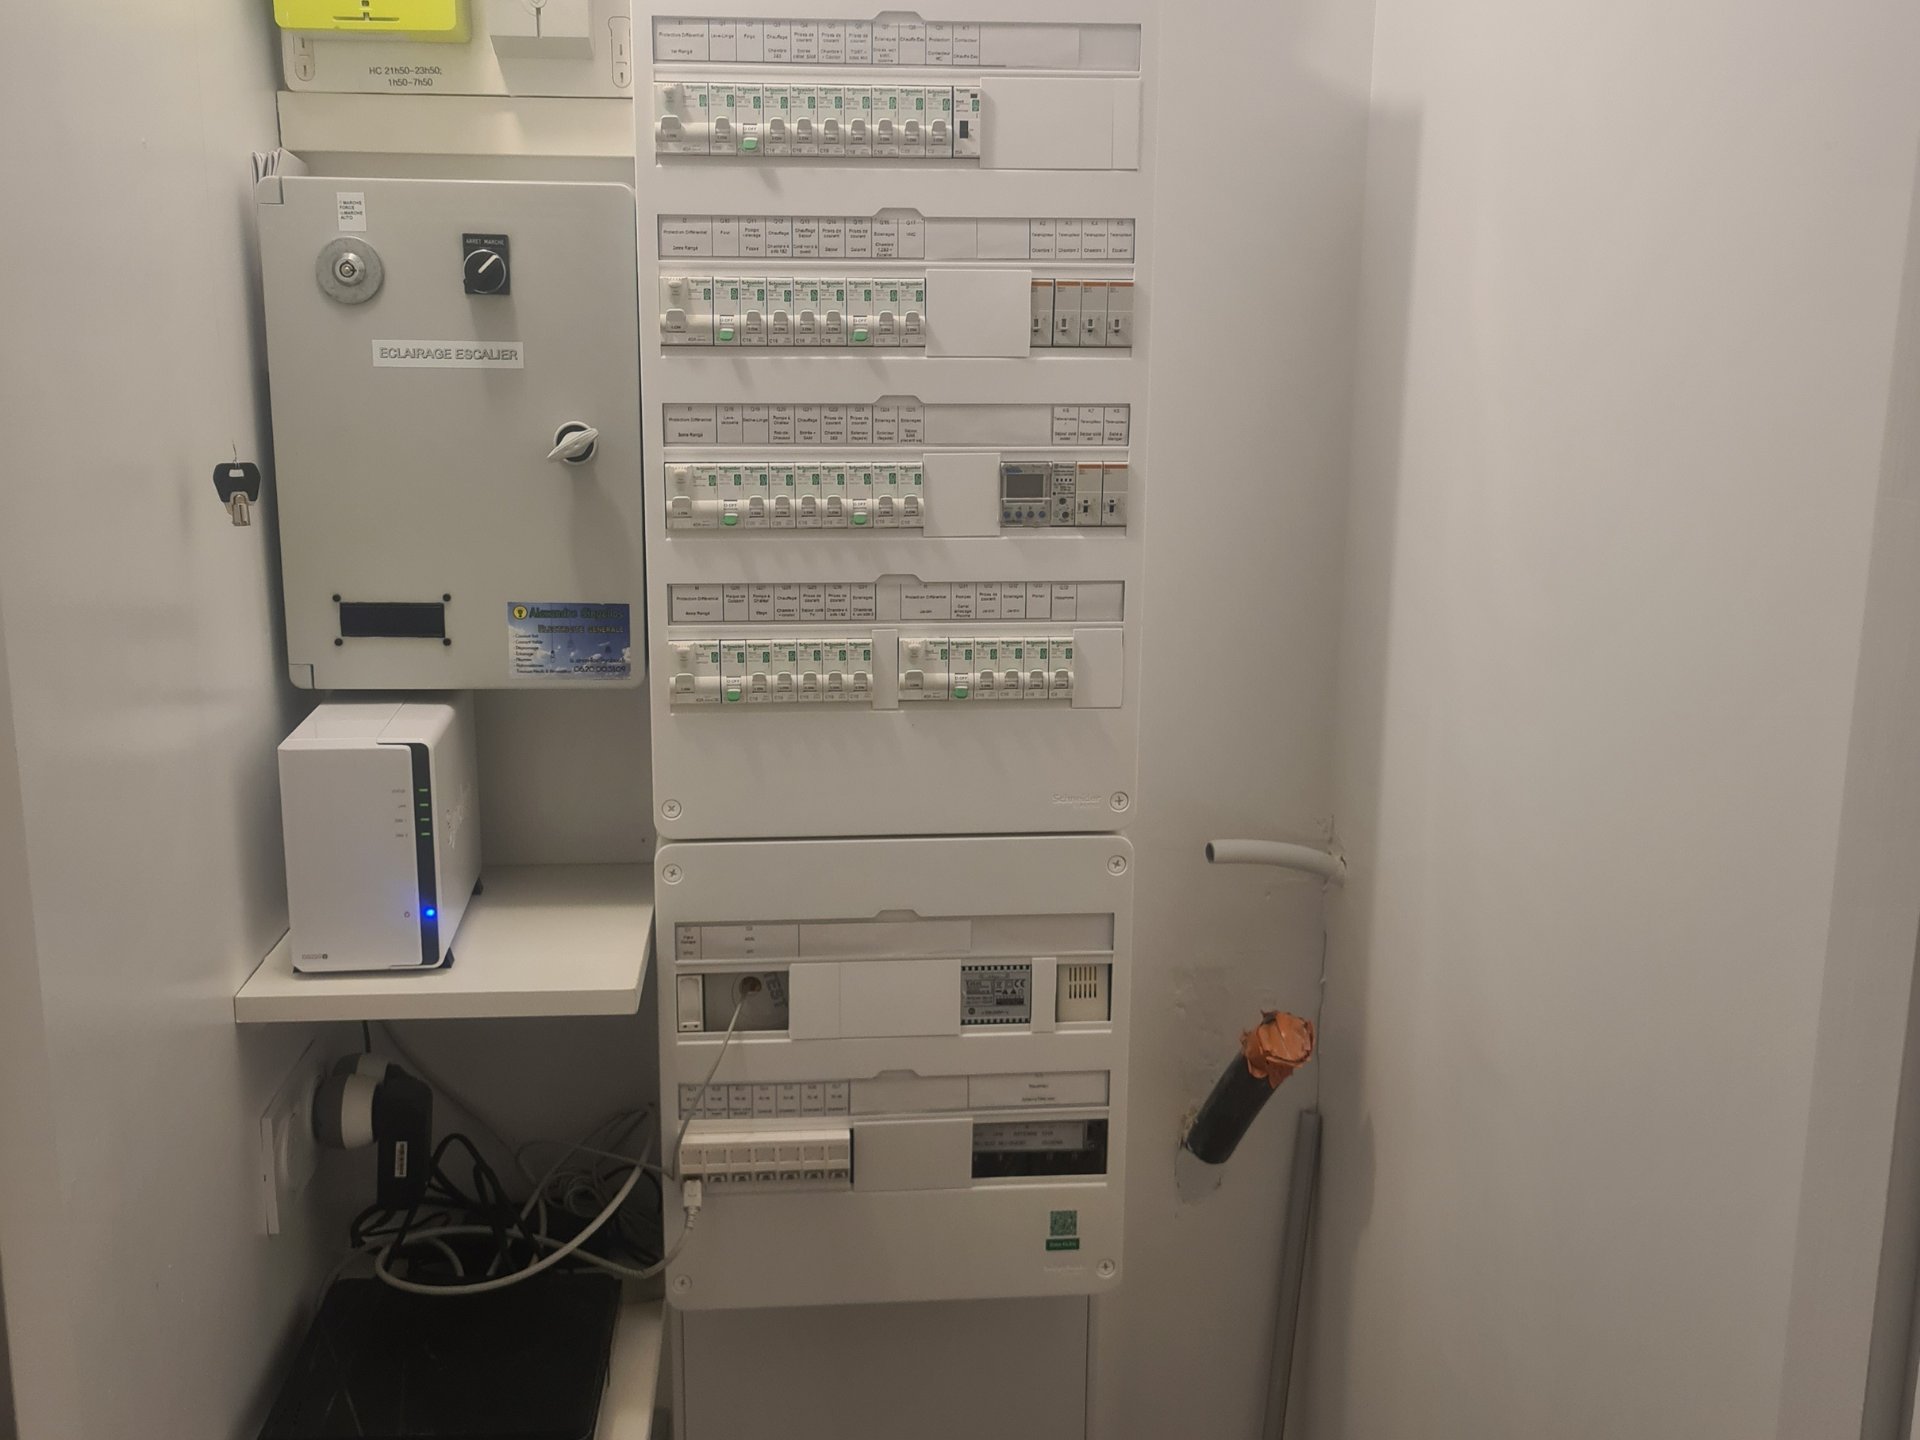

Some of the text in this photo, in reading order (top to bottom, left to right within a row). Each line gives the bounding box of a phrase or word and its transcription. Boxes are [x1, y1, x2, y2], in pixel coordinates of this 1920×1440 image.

[369, 66, 382, 75] HC
[483, 238, 505, 247] MARCHE
[379, 347, 519, 361] ECLAIRAGE ESCALIER
